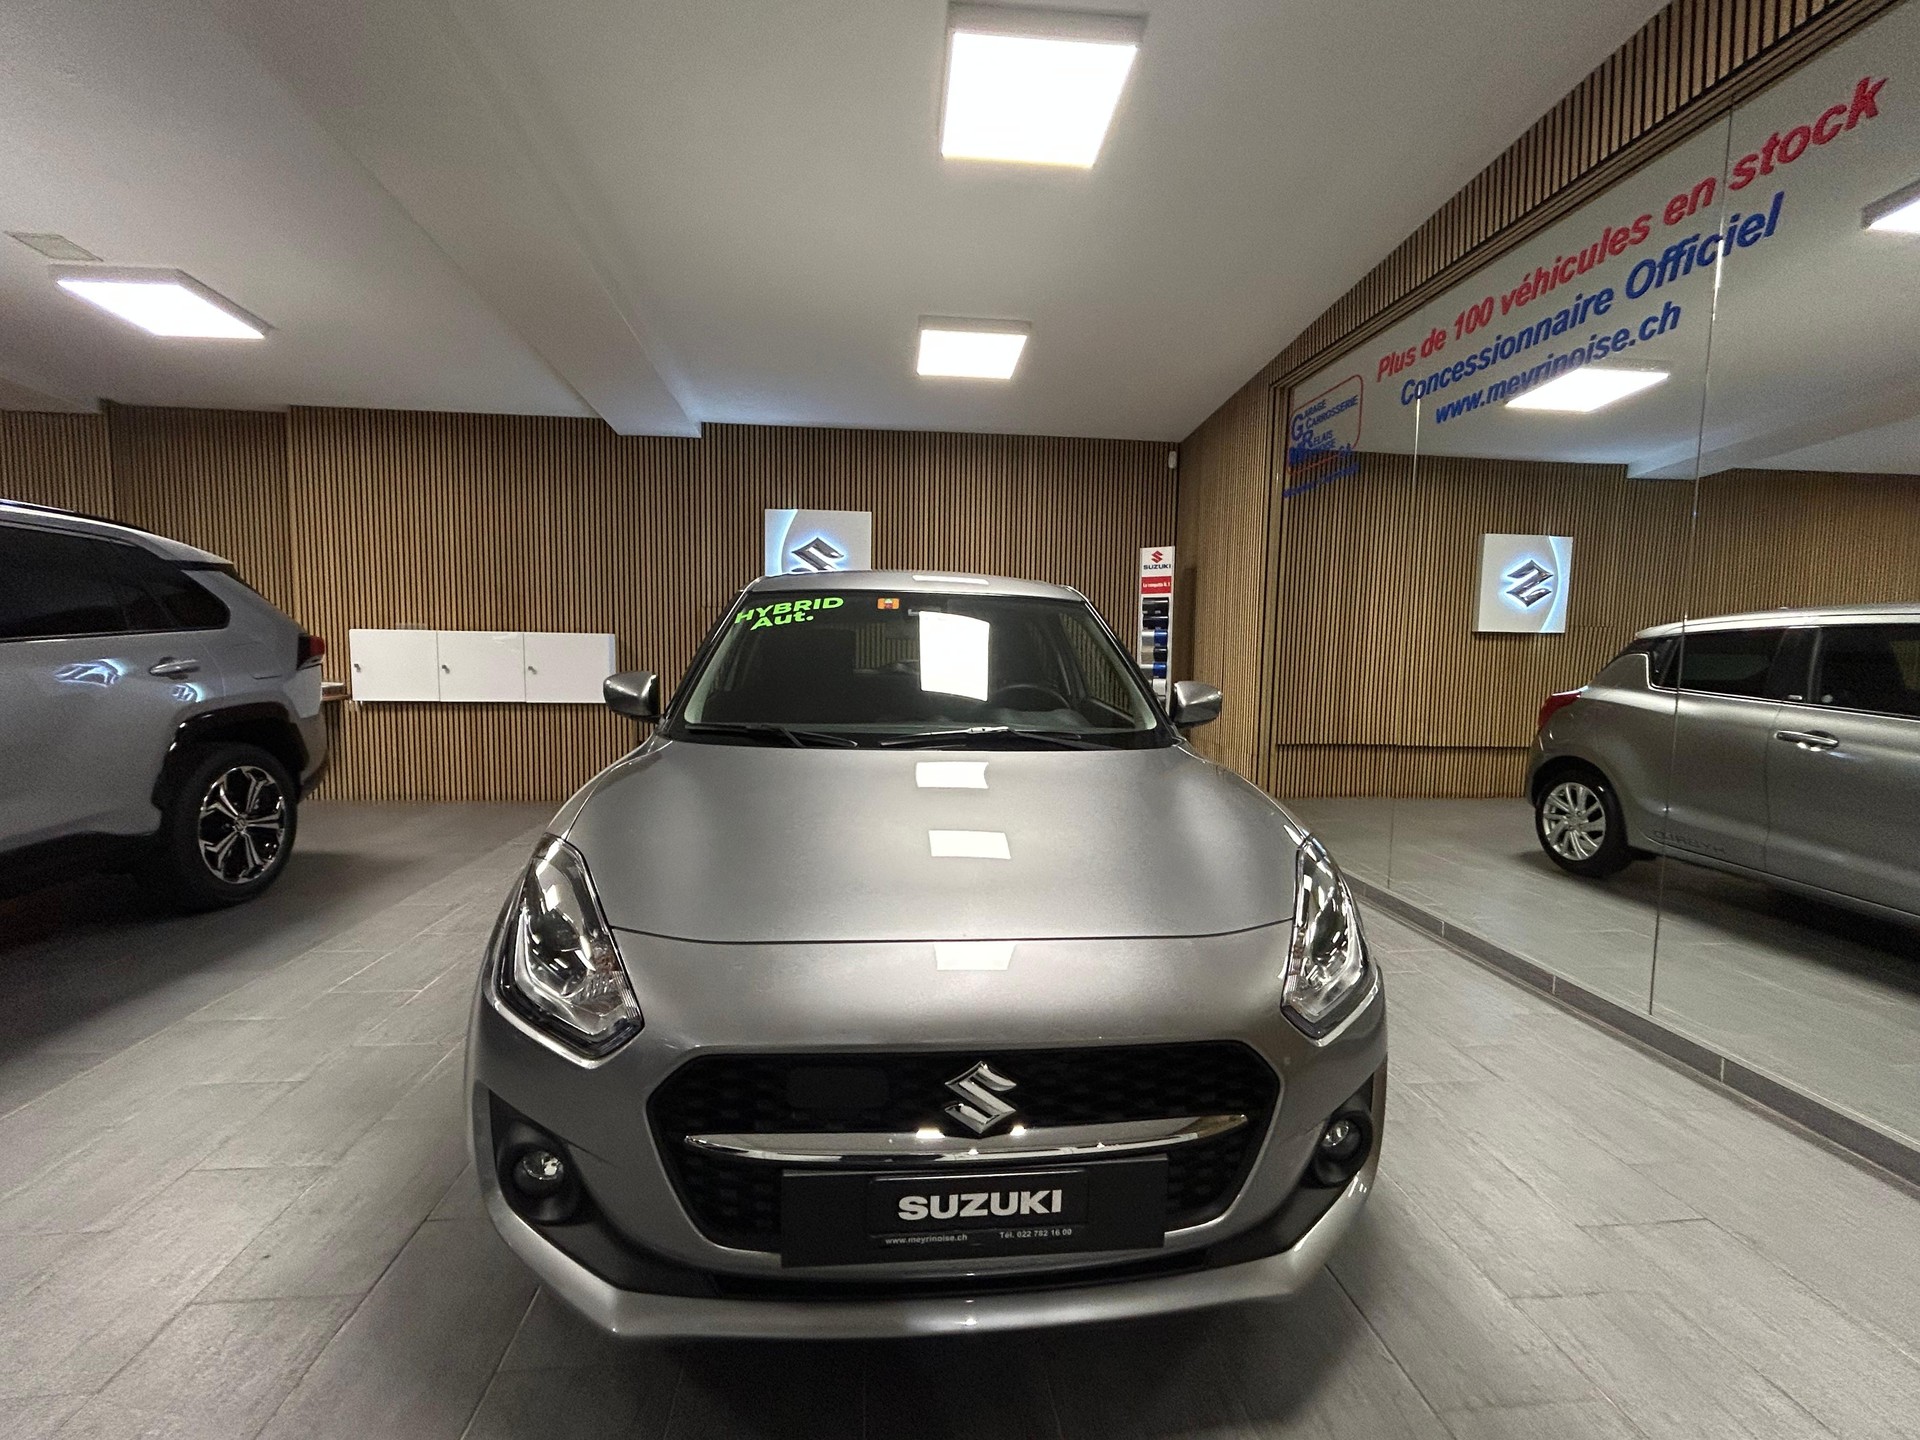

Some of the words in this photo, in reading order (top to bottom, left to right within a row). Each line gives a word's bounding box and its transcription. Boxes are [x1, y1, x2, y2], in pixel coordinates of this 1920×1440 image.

[1377, 345, 1417, 383] Plus
[1421, 328, 1446, 359] de
[1454, 296, 1494, 341] 100
[1502, 215, 1653, 316] véhicules
[1663, 176, 1717, 226] en
[1728, 76, 1890, 191] stock
[1401, 287, 1615, 406] Concessionnaire
[1625, 190, 1785, 300] Officiel
[735, 597, 844, 624] HYBRID
[750, 611, 814, 631] Aut.
[898, 1189, 1063, 1221] SUZUKI
[885, 1234, 968, 1246] www.meyrinoise.ch
[1017, 1230, 1032, 1238] 022
[1034, 1229, 1049, 1237] 782
[1051, 1228, 1061, 1236] 16
[1062, 1228, 1073, 1236] 00
